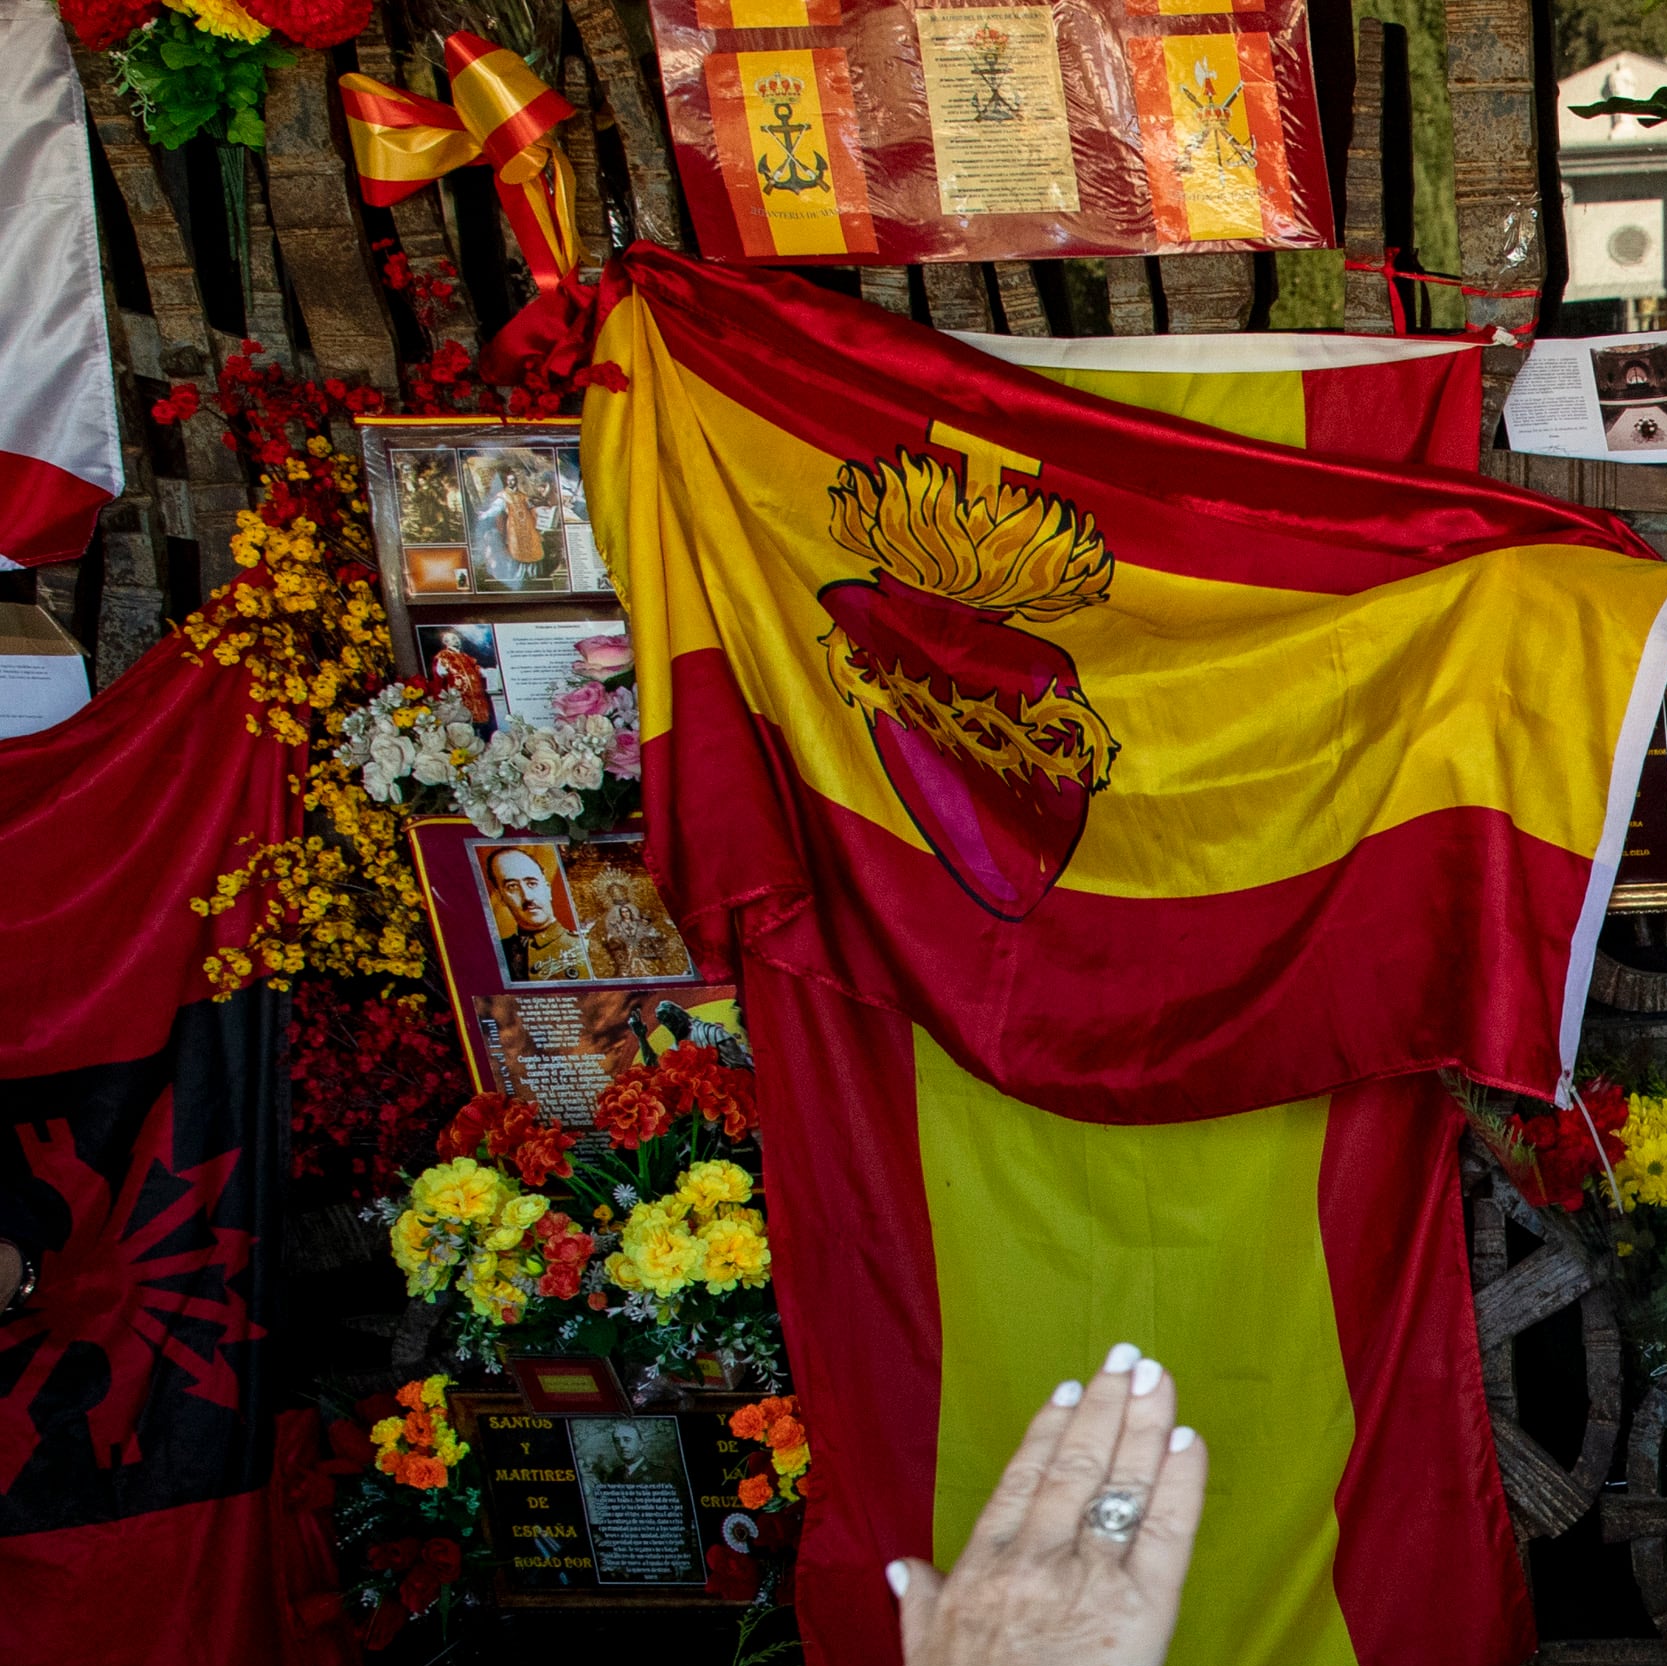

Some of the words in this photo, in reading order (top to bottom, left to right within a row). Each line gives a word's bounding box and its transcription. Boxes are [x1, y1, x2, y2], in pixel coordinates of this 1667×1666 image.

[489, 1416, 553, 1429] SANTOS
[717, 1414, 726, 1426] Y
[520, 1443, 530, 1454] Y
[717, 1440, 739, 1453] DE
[496, 1469, 576, 1482] MARTIRES
[528, 1497, 549, 1509] DE
[512, 1525, 577, 1538] ESPAÑA
[514, 1557, 562, 1569] ROGAD
[564, 1557, 592, 1569] POR
